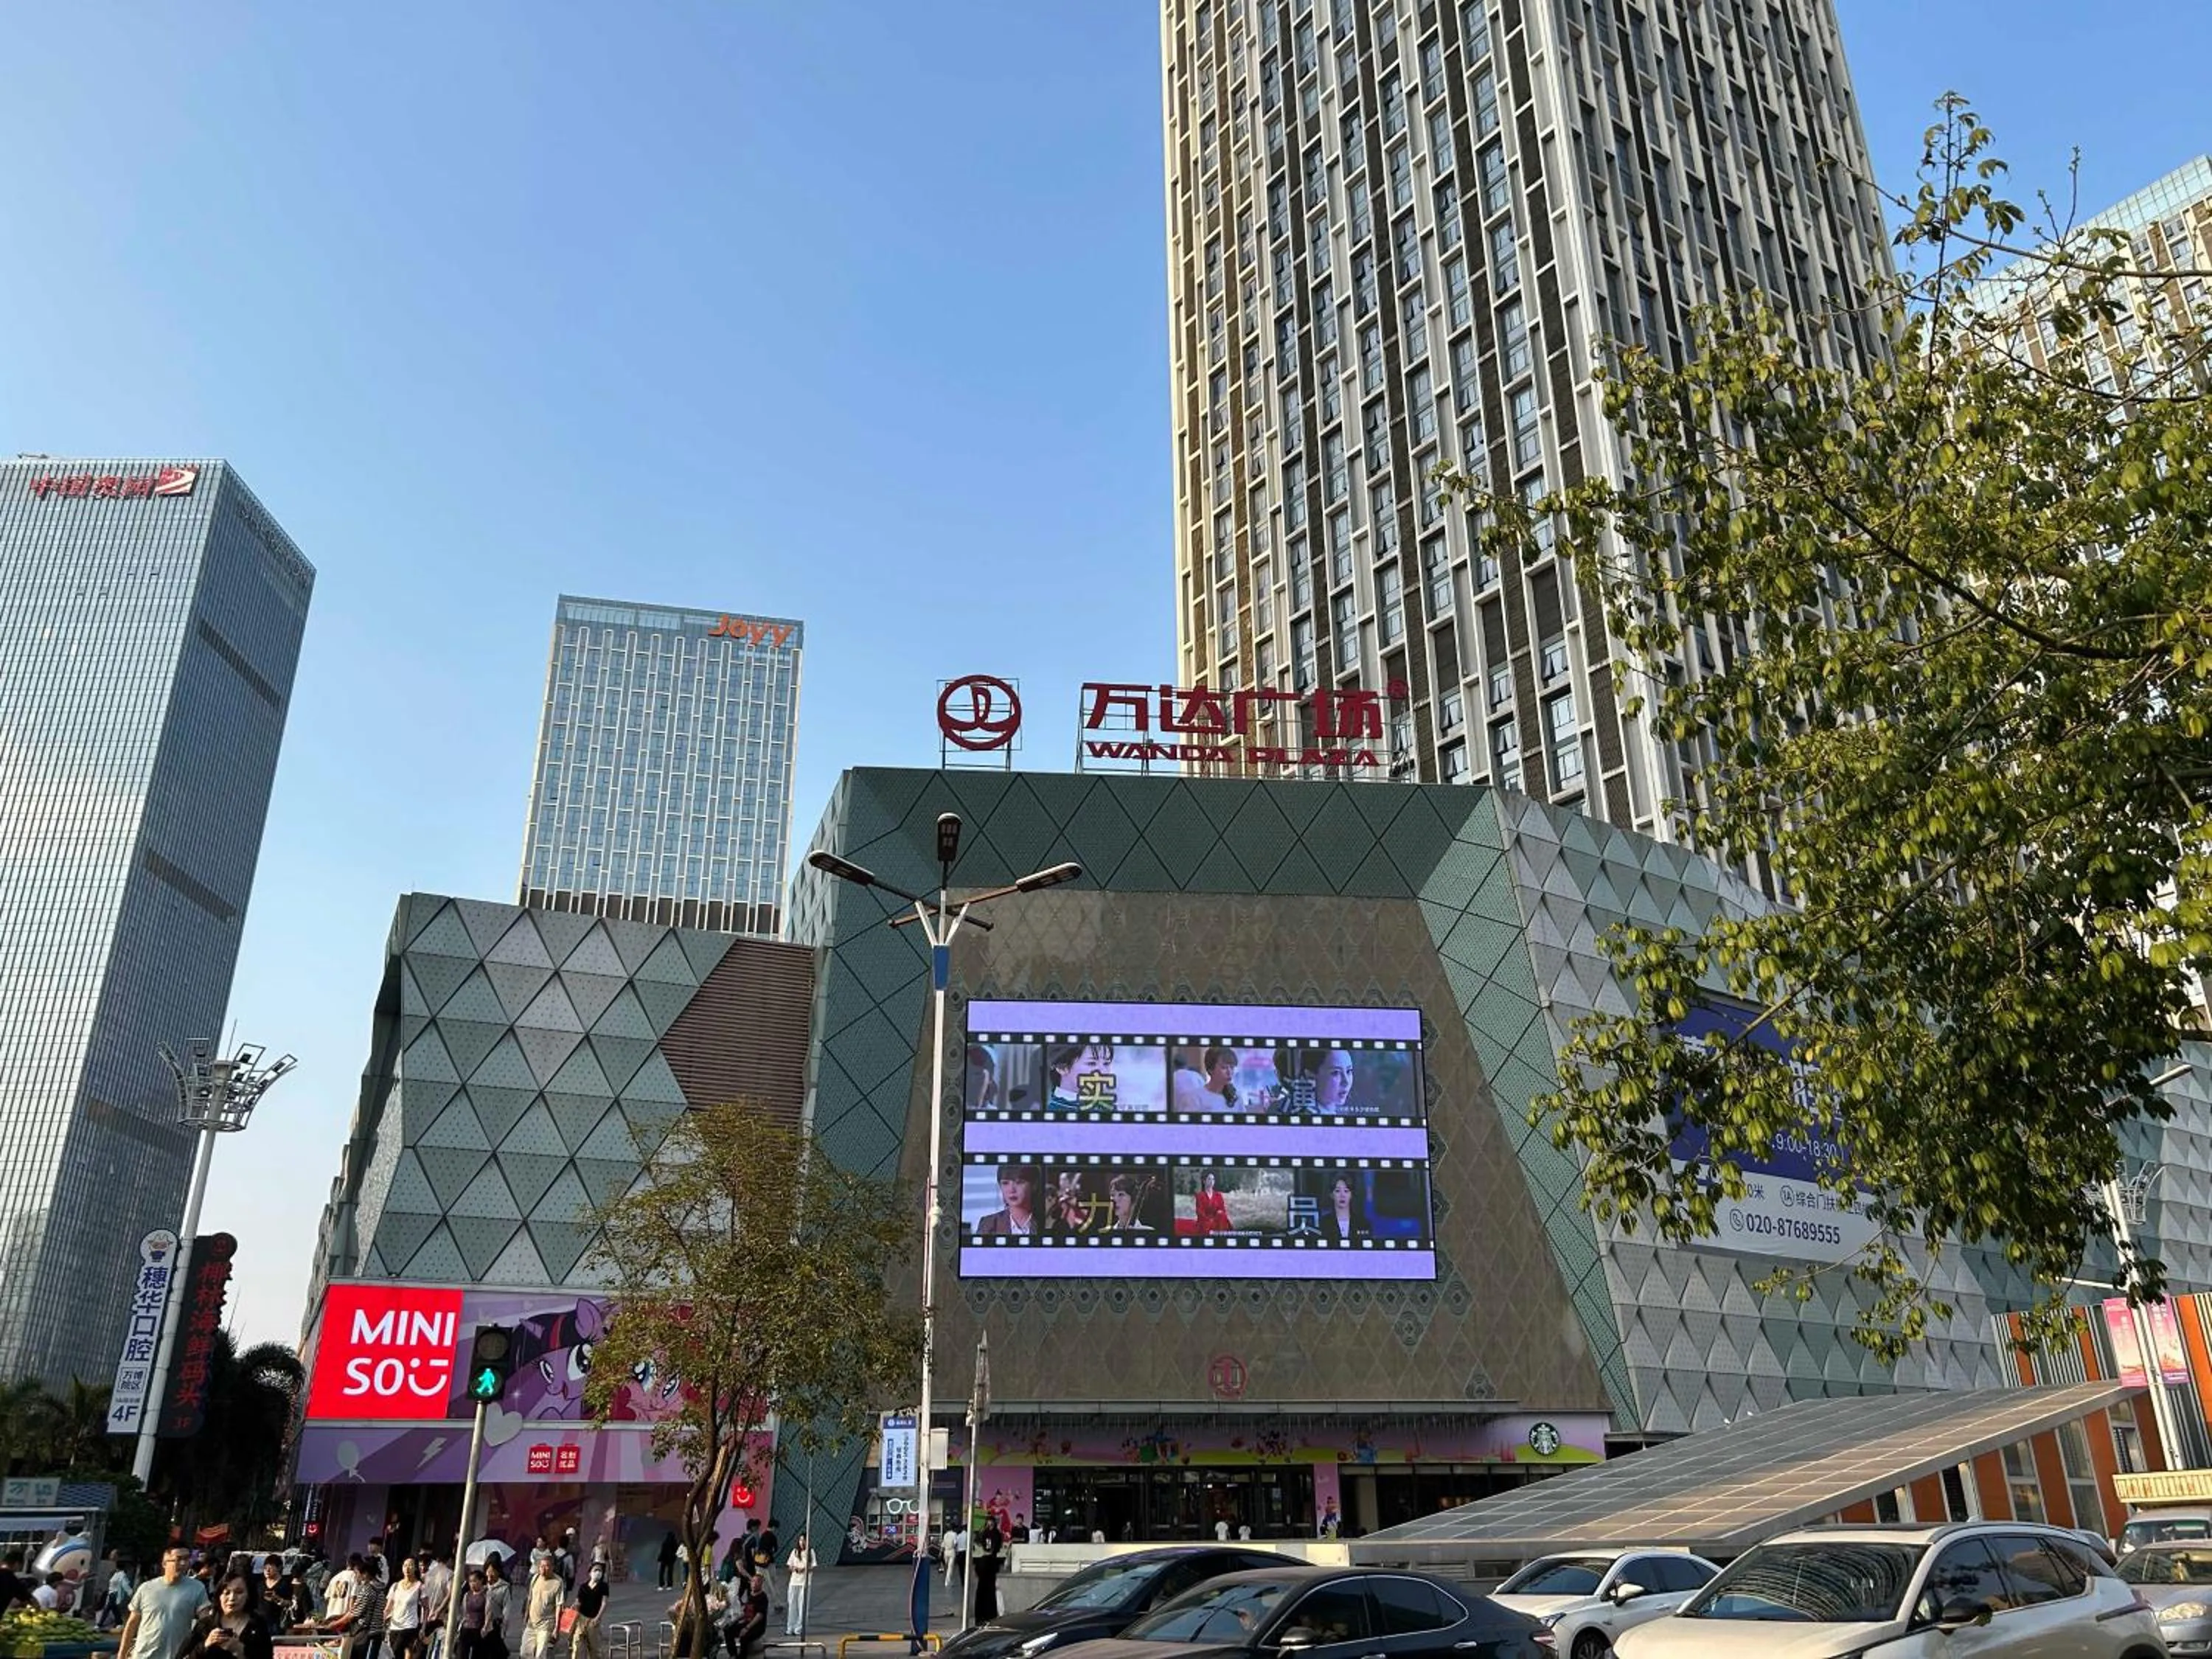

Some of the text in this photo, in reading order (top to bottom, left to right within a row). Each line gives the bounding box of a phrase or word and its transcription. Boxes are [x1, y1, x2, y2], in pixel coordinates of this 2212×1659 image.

[1082, 683, 1382, 739] 万达广场
[1086, 742, 1380, 766] WANDA PLAZA
[1746, 1213, 1840, 1245] 020-87689555
[125, 1266, 169, 1363] 穗华口腔
[350, 1309, 456, 1346] MINI
[111, 1405, 139, 1422] 4F
[531, 1451, 551, 1459] MINI
